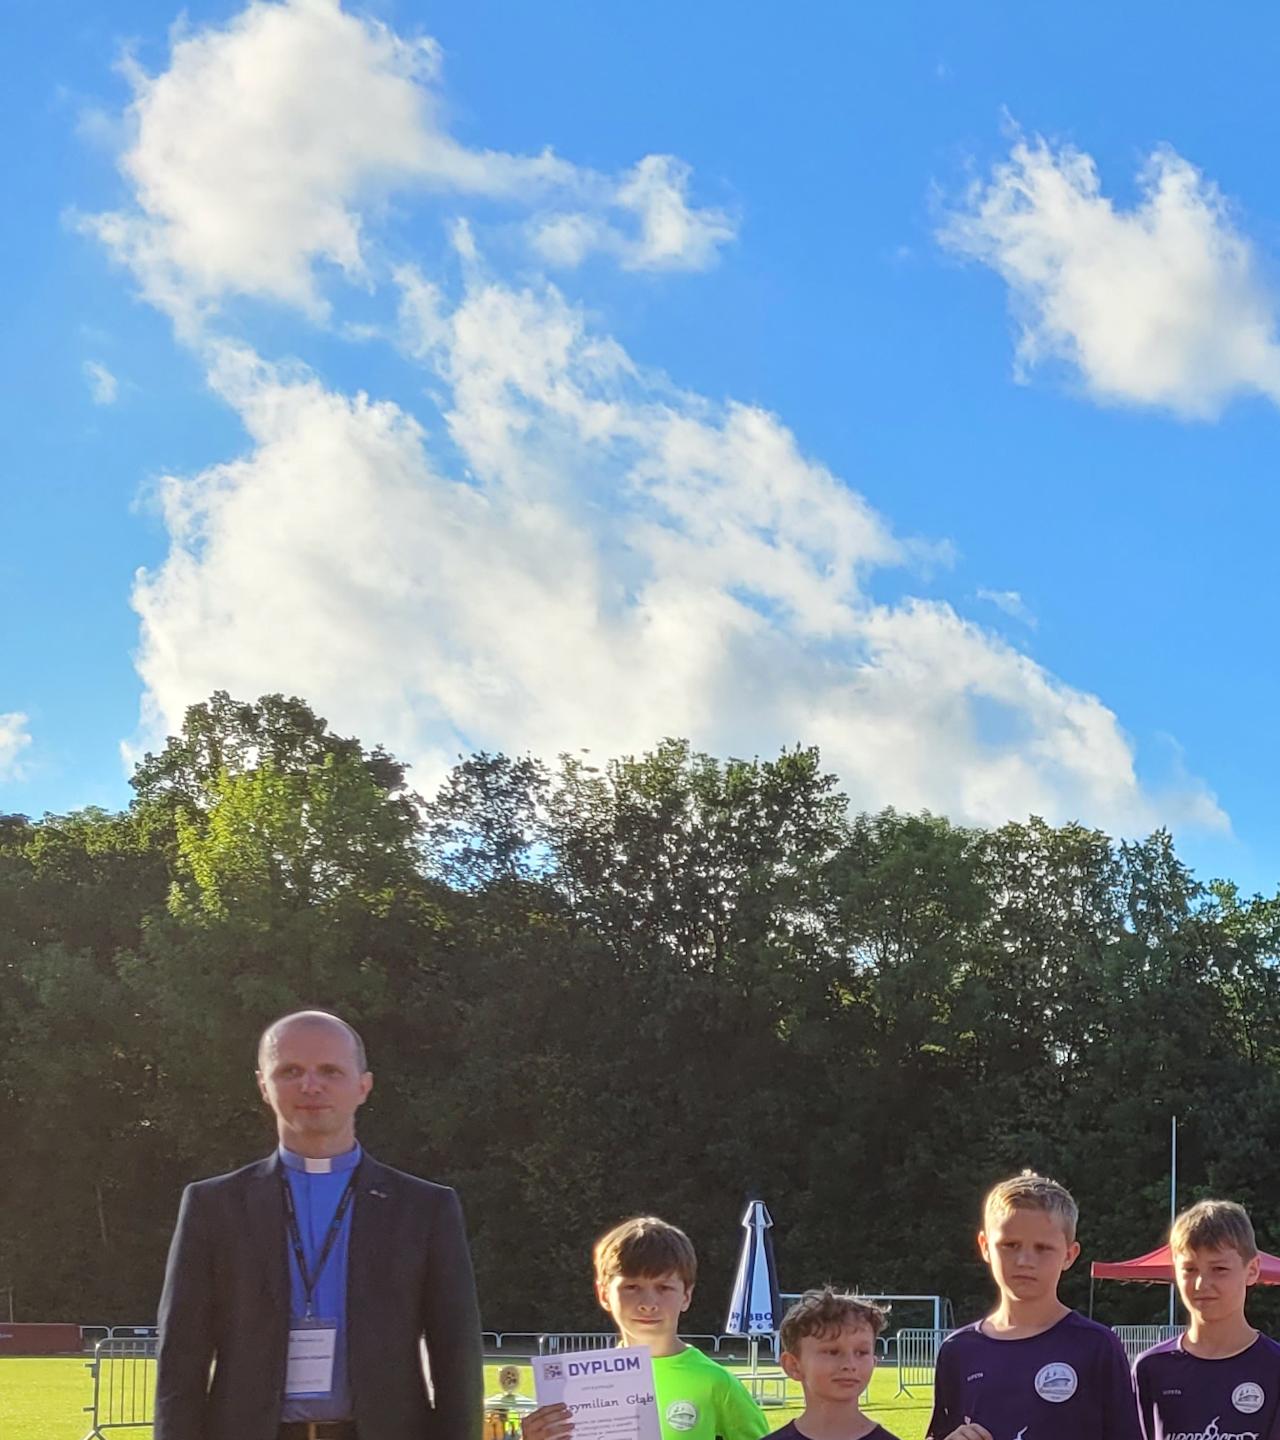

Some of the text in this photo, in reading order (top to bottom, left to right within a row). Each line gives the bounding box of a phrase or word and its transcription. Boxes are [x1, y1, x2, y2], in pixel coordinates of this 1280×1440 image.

[568, 1356, 641, 1377] DYPLOM
[569, 1393, 654, 1414] symilian Głąb
